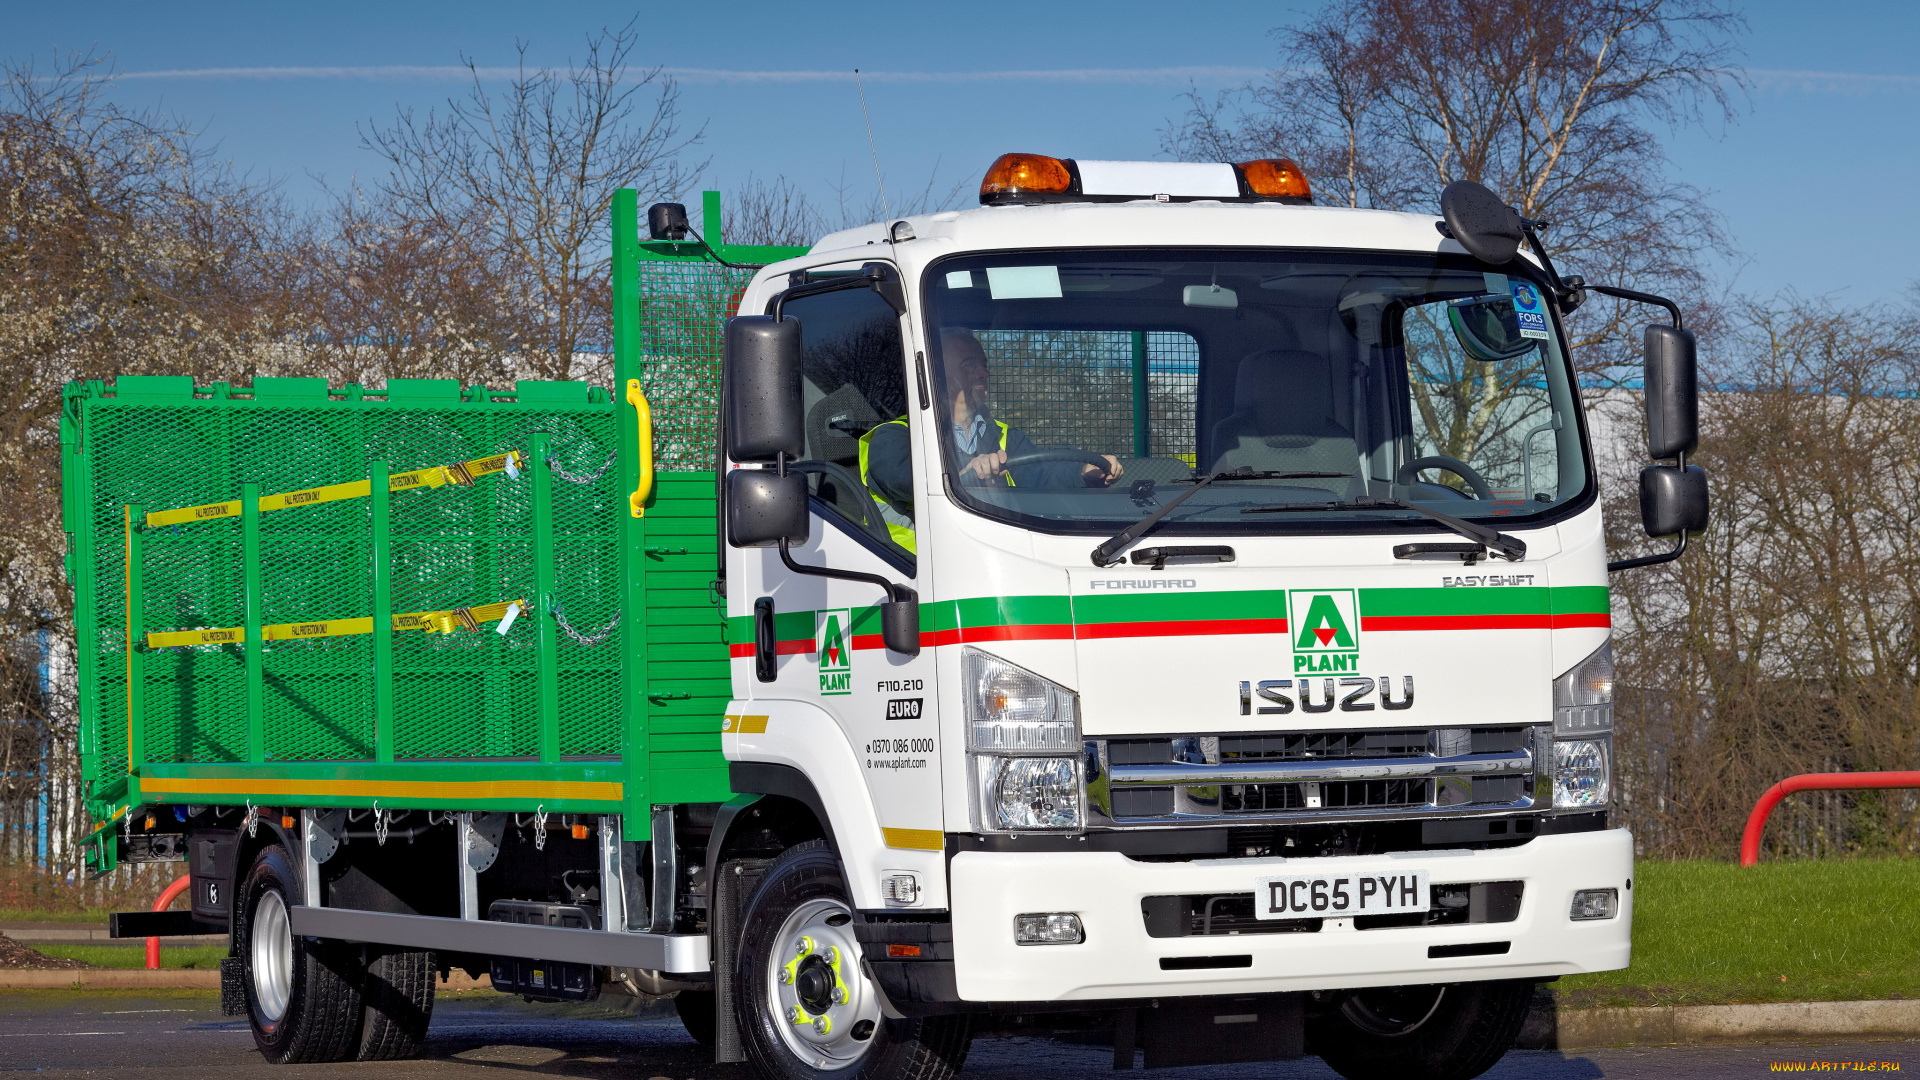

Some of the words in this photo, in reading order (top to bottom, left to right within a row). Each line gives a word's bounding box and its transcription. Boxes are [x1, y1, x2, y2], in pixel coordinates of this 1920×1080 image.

[1518, 313, 1543, 323] FORS
[391, 475, 410, 488] PROTECTION
[285, 495, 293, 506] FALL
[293, 491, 312, 504] PROTECTION
[311, 490, 320, 501] ONLY
[195, 508, 203, 518] FALL
[202, 505, 221, 517] PROTECTION
[1090, 578, 1197, 590] FORWARD
[1296, 595, 1355, 648] A
[202, 632, 210, 642] FALL
[209, 631, 228, 641] PROTECTION
[292, 625, 300, 636] FALL
[299, 624, 319, 635] PROTECTION
[820, 614, 849, 668] A
[1293, 654, 1359, 672] PLANT
[819, 673, 851, 691] PLANT
[877, 679, 923, 692] F110.210
[1239, 675, 1414, 716] ISUZU
[872, 739, 890, 753] 0370
[893, 738, 909, 753] 086
[911, 738, 934, 753] 0000
[873, 756, 927, 772] www.aplant.com
[1269, 878, 1350, 914] DC65
[1359, 875, 1418, 909] PYH
